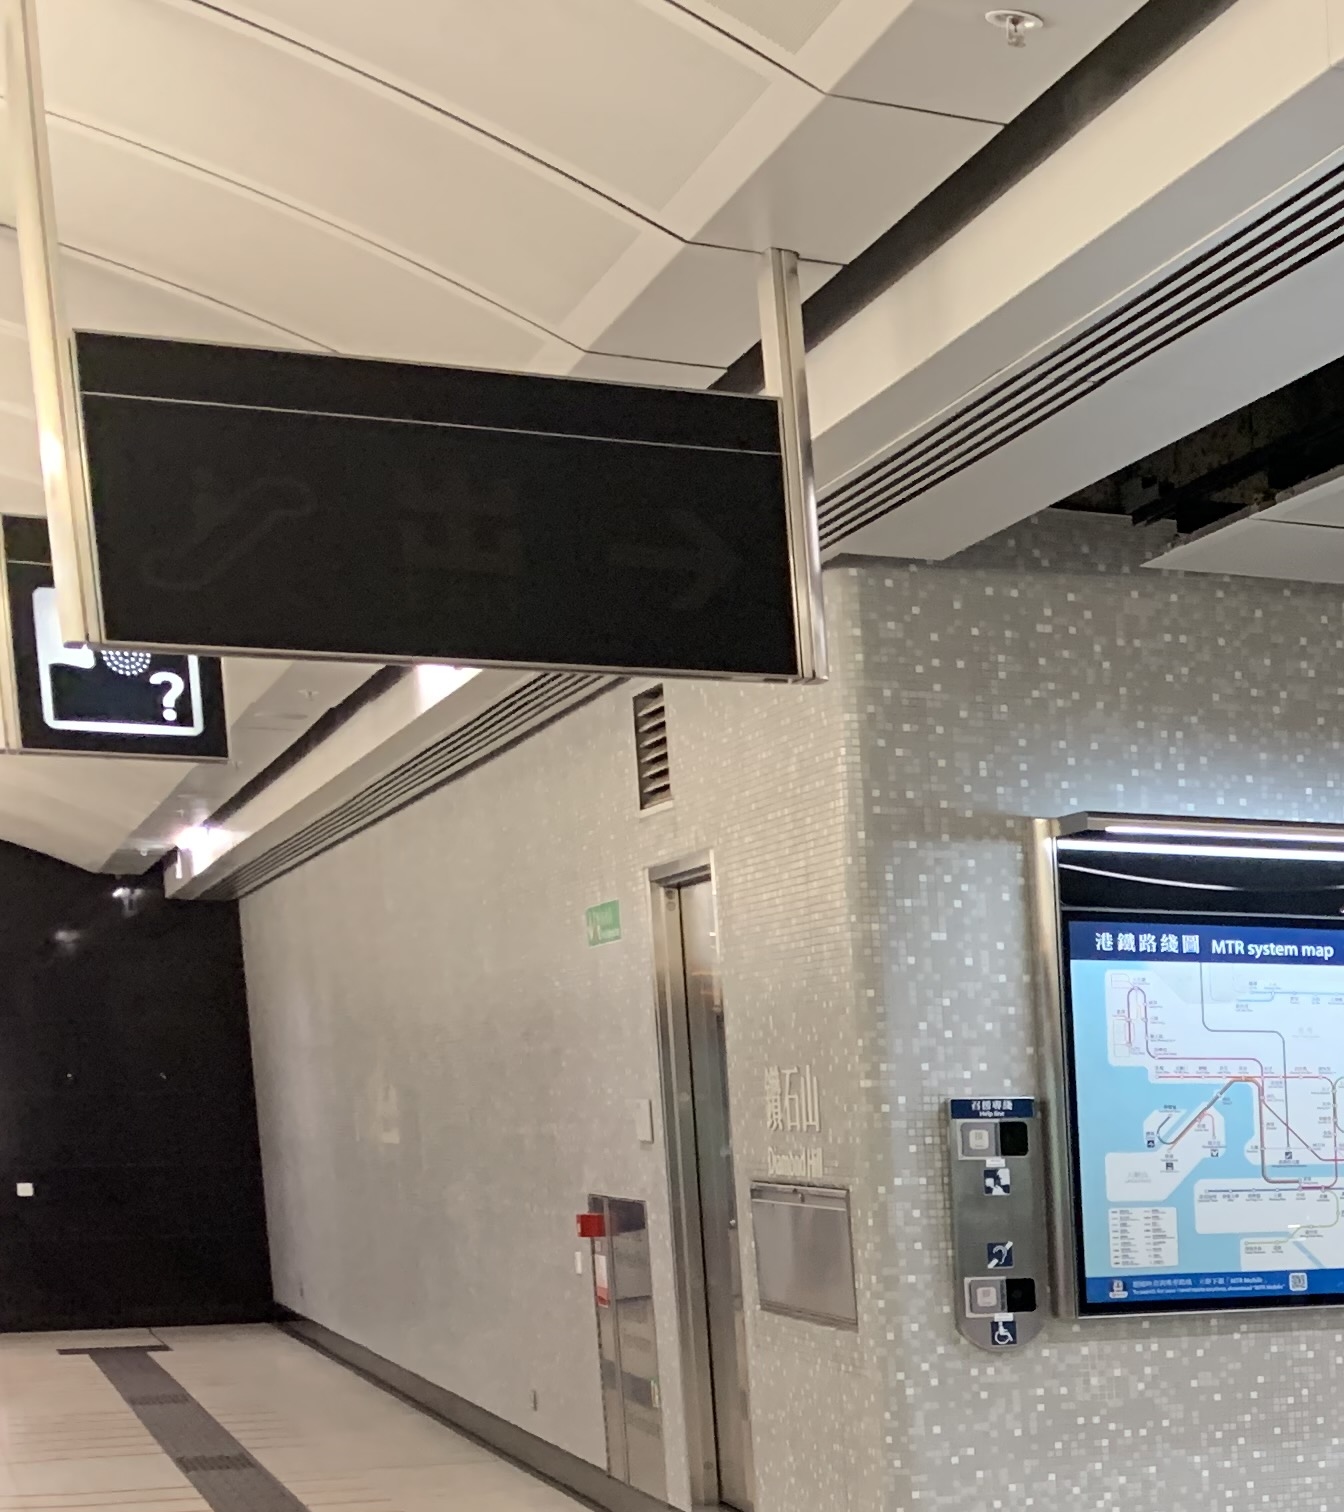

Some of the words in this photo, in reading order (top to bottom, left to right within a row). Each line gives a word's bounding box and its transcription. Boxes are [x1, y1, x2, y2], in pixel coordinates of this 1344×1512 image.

[1211, 939, 1245, 955] MTR
[1247, 942, 1299, 959] system
[1301, 944, 1335, 961] map
